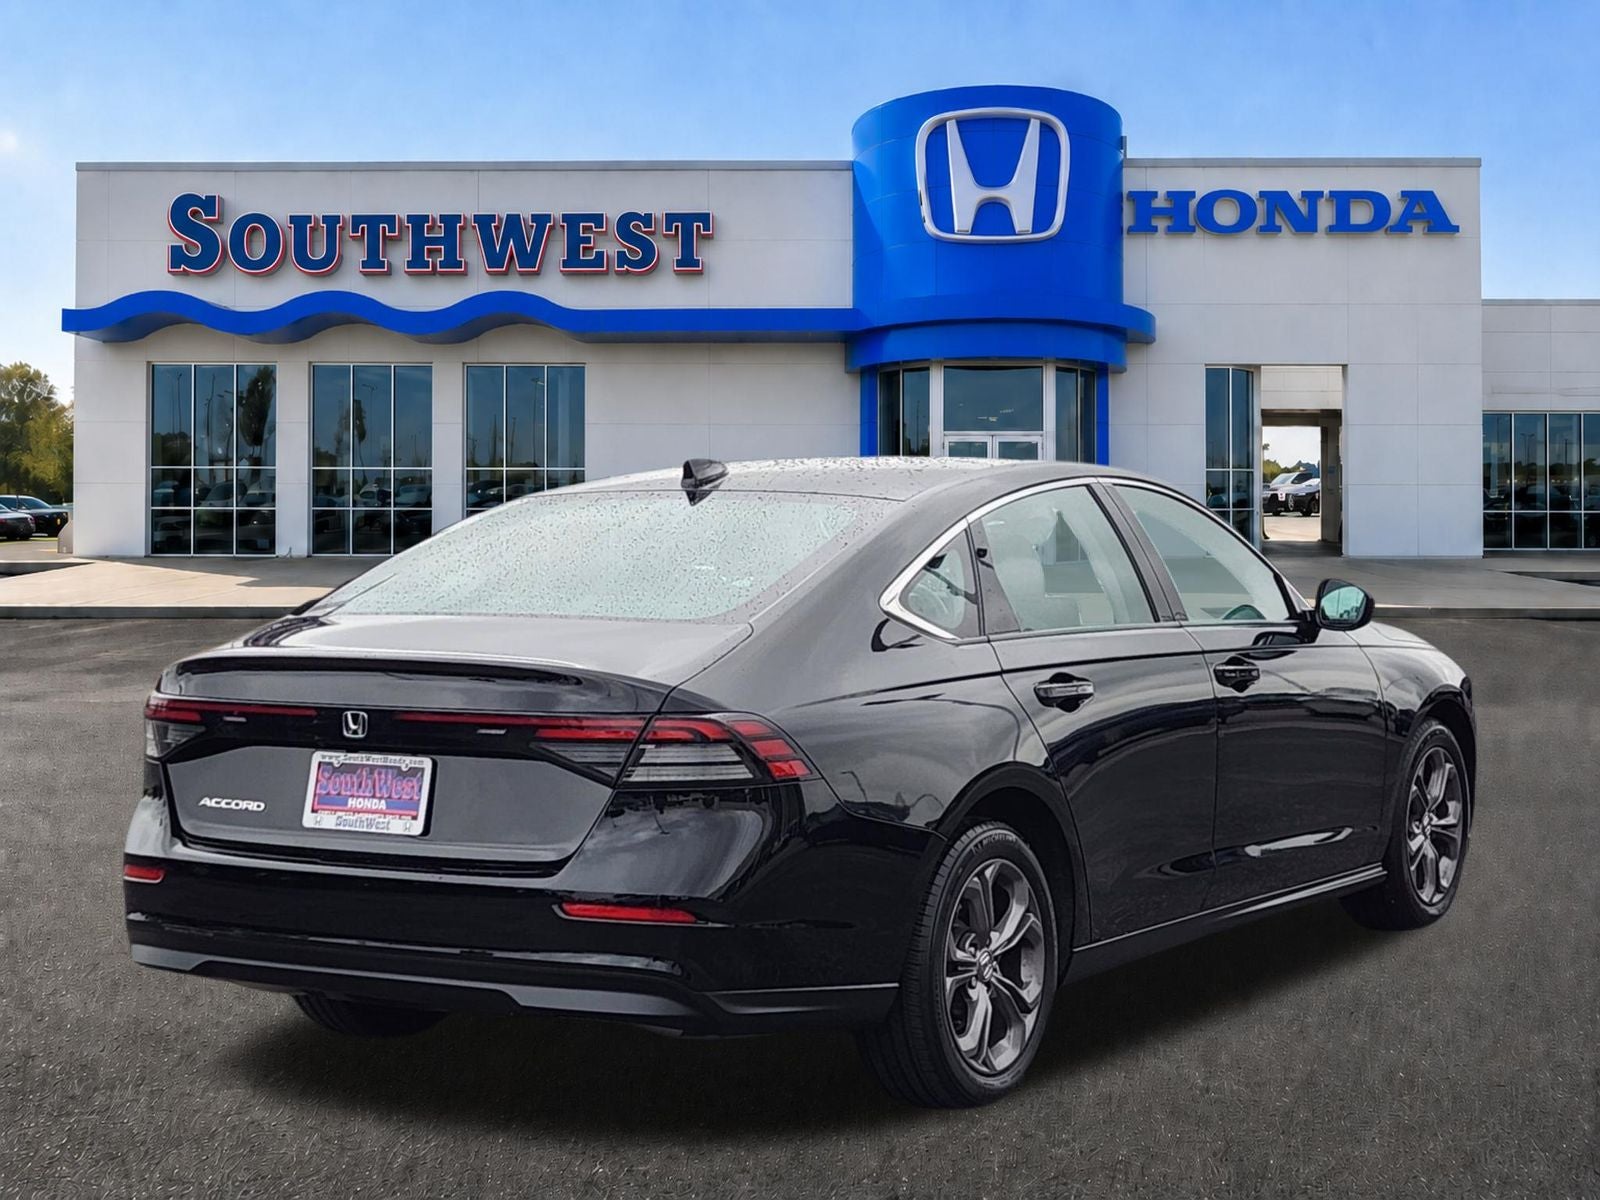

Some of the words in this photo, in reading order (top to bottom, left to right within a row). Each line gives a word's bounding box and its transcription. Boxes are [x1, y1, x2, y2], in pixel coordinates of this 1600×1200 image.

[1128, 189, 1460, 235] HONDA
[167, 192, 714, 277] SOUTHWEST
[198, 797, 266, 811] ACCORD
[347, 797, 388, 810] HONDA
